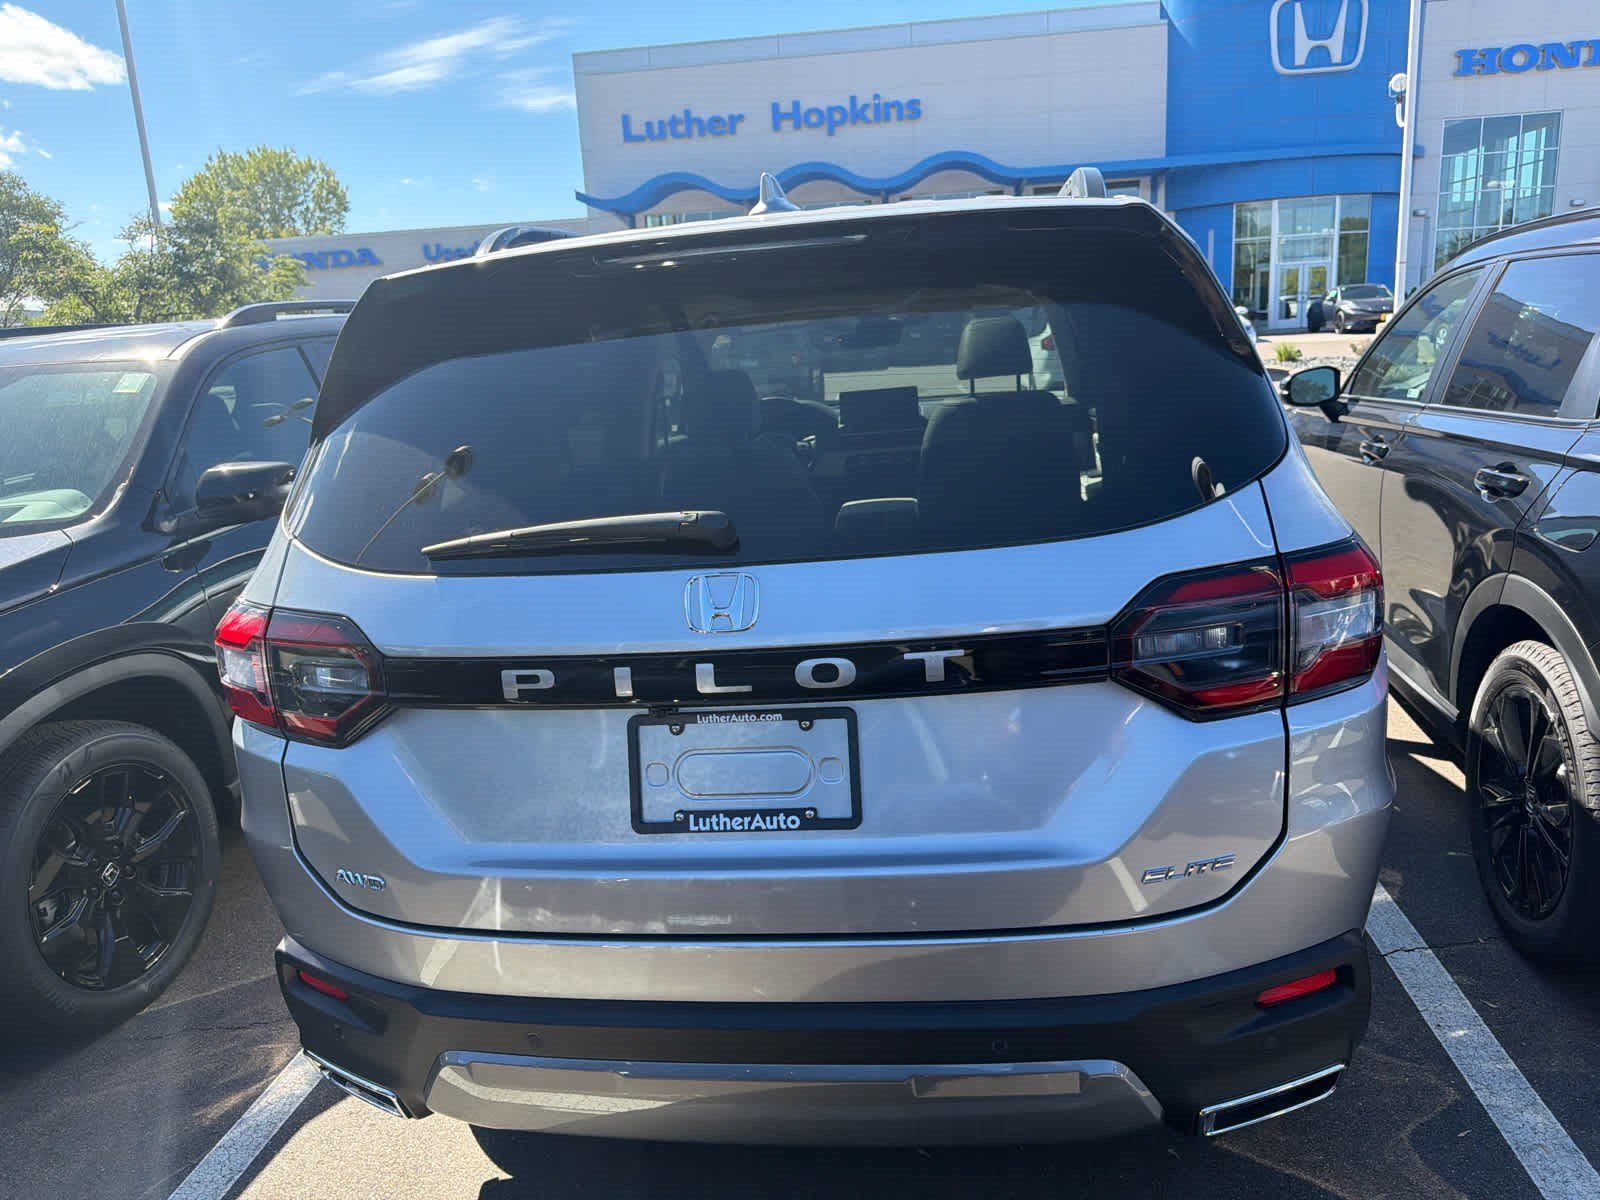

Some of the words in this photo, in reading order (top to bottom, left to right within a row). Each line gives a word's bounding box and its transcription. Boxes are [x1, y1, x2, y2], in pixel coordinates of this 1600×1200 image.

[621, 108, 745, 143] Luther
[771, 93, 922, 136] Hopkins
[256, 247, 384, 272] NDA
[501, 648, 965, 700] PILOT
[696, 712, 783, 724] LutherAuto.com
[689, 812, 801, 832] LutherAuto
[335, 868, 385, 891] AWD
[1141, 852, 1237, 884] ELITE
